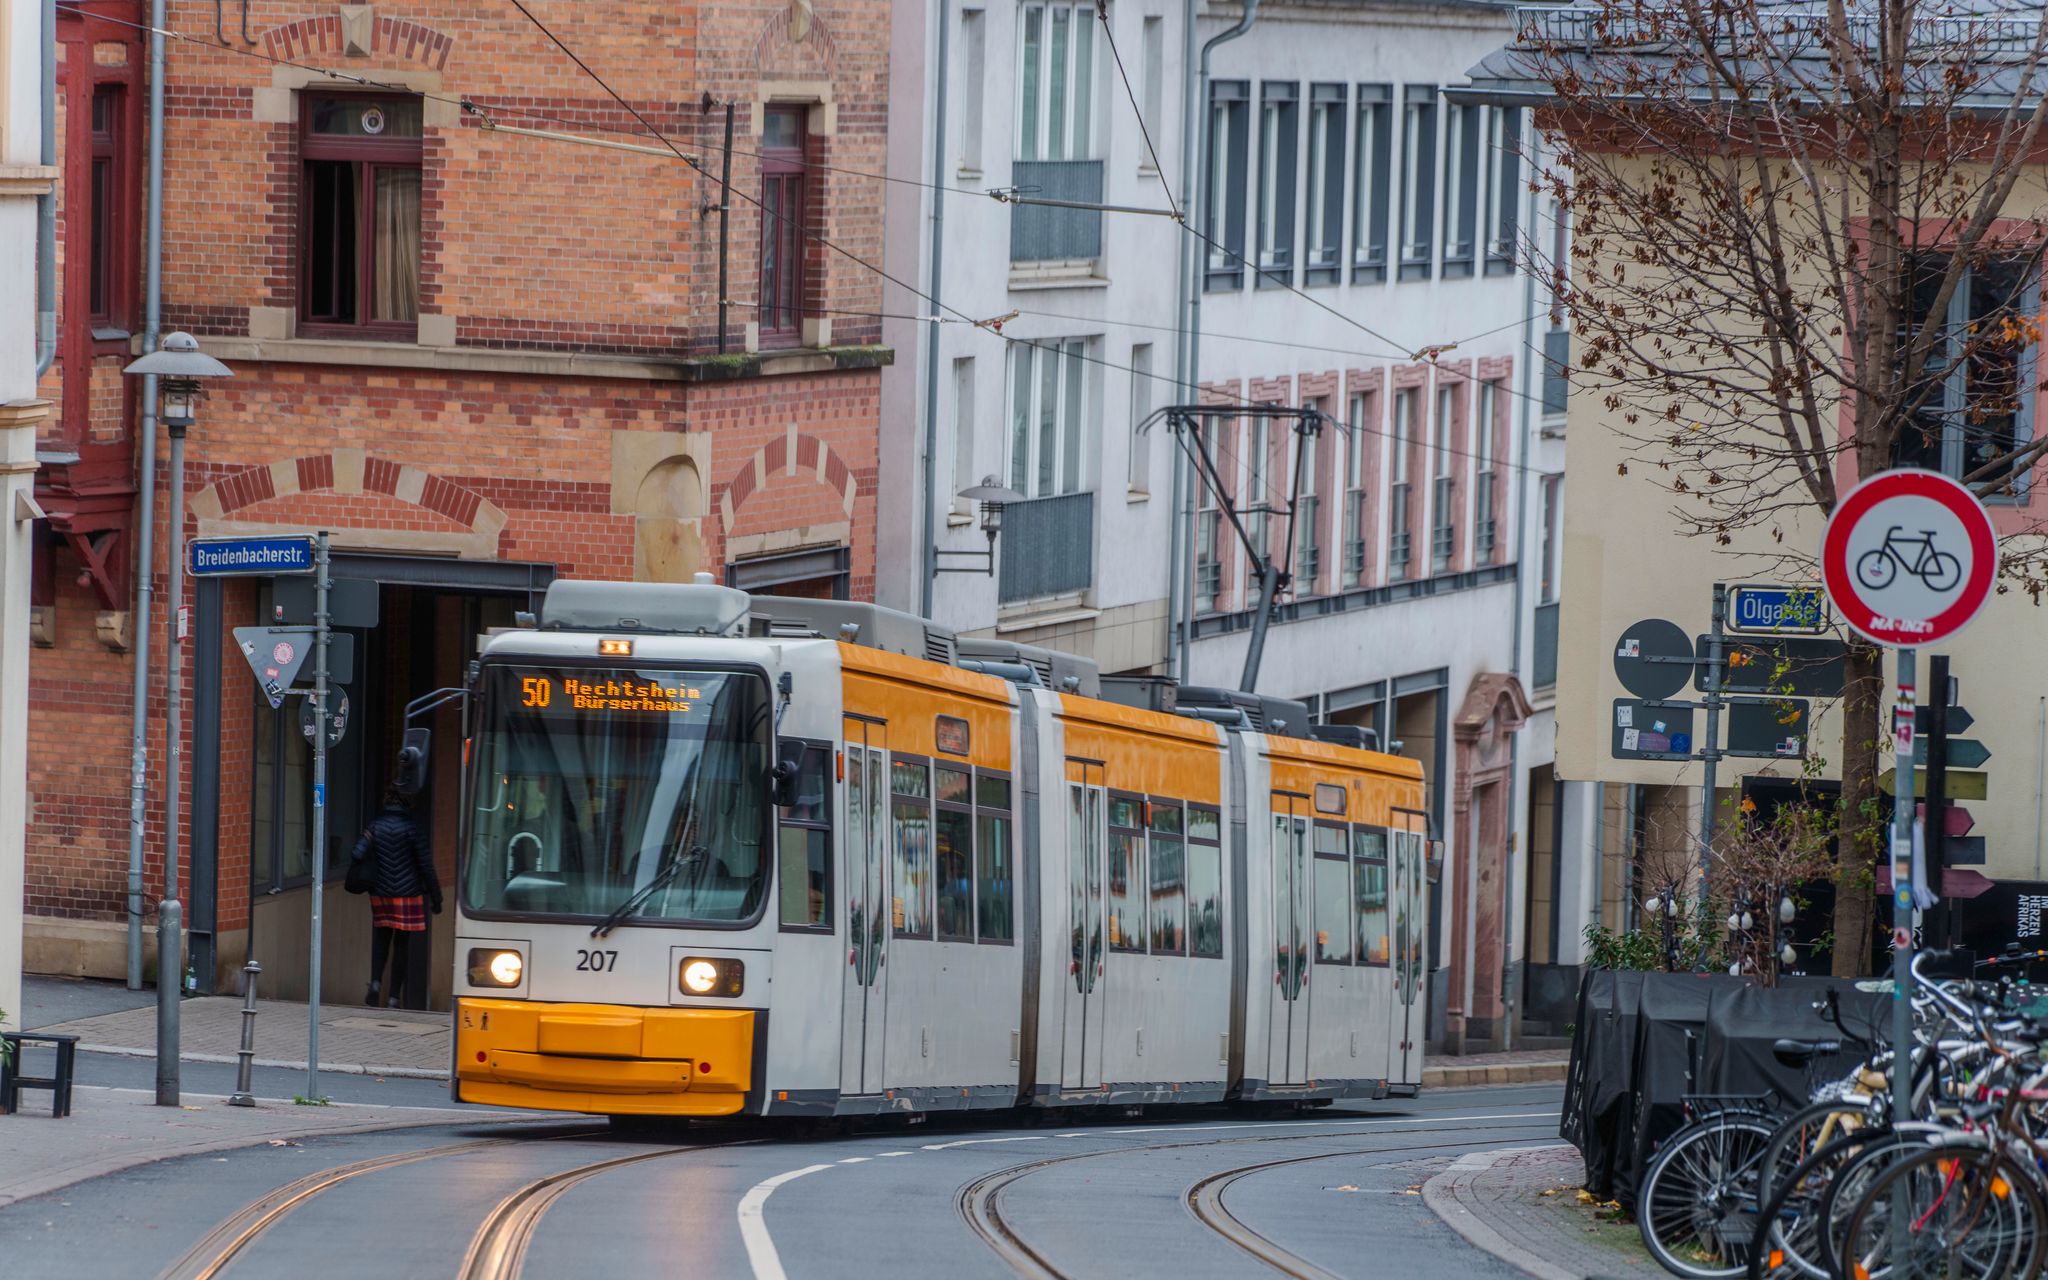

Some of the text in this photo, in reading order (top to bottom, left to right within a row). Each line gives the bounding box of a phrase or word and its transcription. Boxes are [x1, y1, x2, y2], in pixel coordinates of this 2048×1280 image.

[197, 546, 305, 566] Breidenbacherstr.
[522, 676, 550, 708] 50
[565, 679, 701, 698] Hechtsheim
[574, 695, 690, 711] Bürgerhaus
[2017, 894, 2029, 938] AFRIKAS
[2029, 895, 2041, 936] HERZEN
[577, 949, 619, 973] 207
